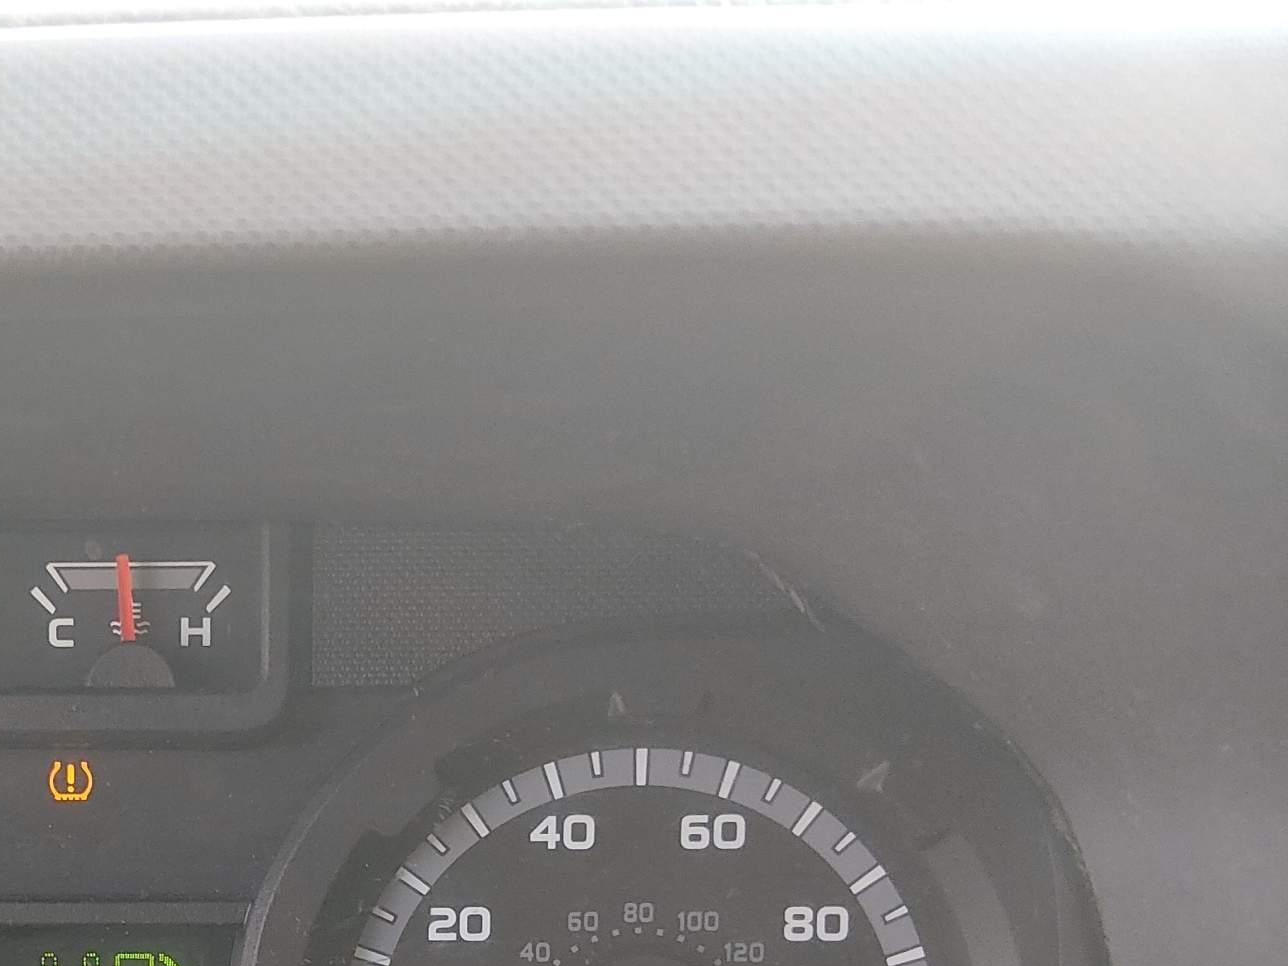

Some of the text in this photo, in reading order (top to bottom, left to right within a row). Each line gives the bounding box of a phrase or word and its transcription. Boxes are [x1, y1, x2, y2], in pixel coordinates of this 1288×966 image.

[48, 617, 75, 648] C
[180, 617, 211, 647] H
[529, 814, 595, 850] 40
[680, 813, 746, 850] 60
[428, 906, 491, 942] 20
[567, 911, 599, 932] 60
[623, 902, 654, 923] 80
[677, 910, 720, 932] 100
[783, 906, 849, 942] 80
[519, 942, 551, 963] 40
[723, 941, 765, 963] 120
